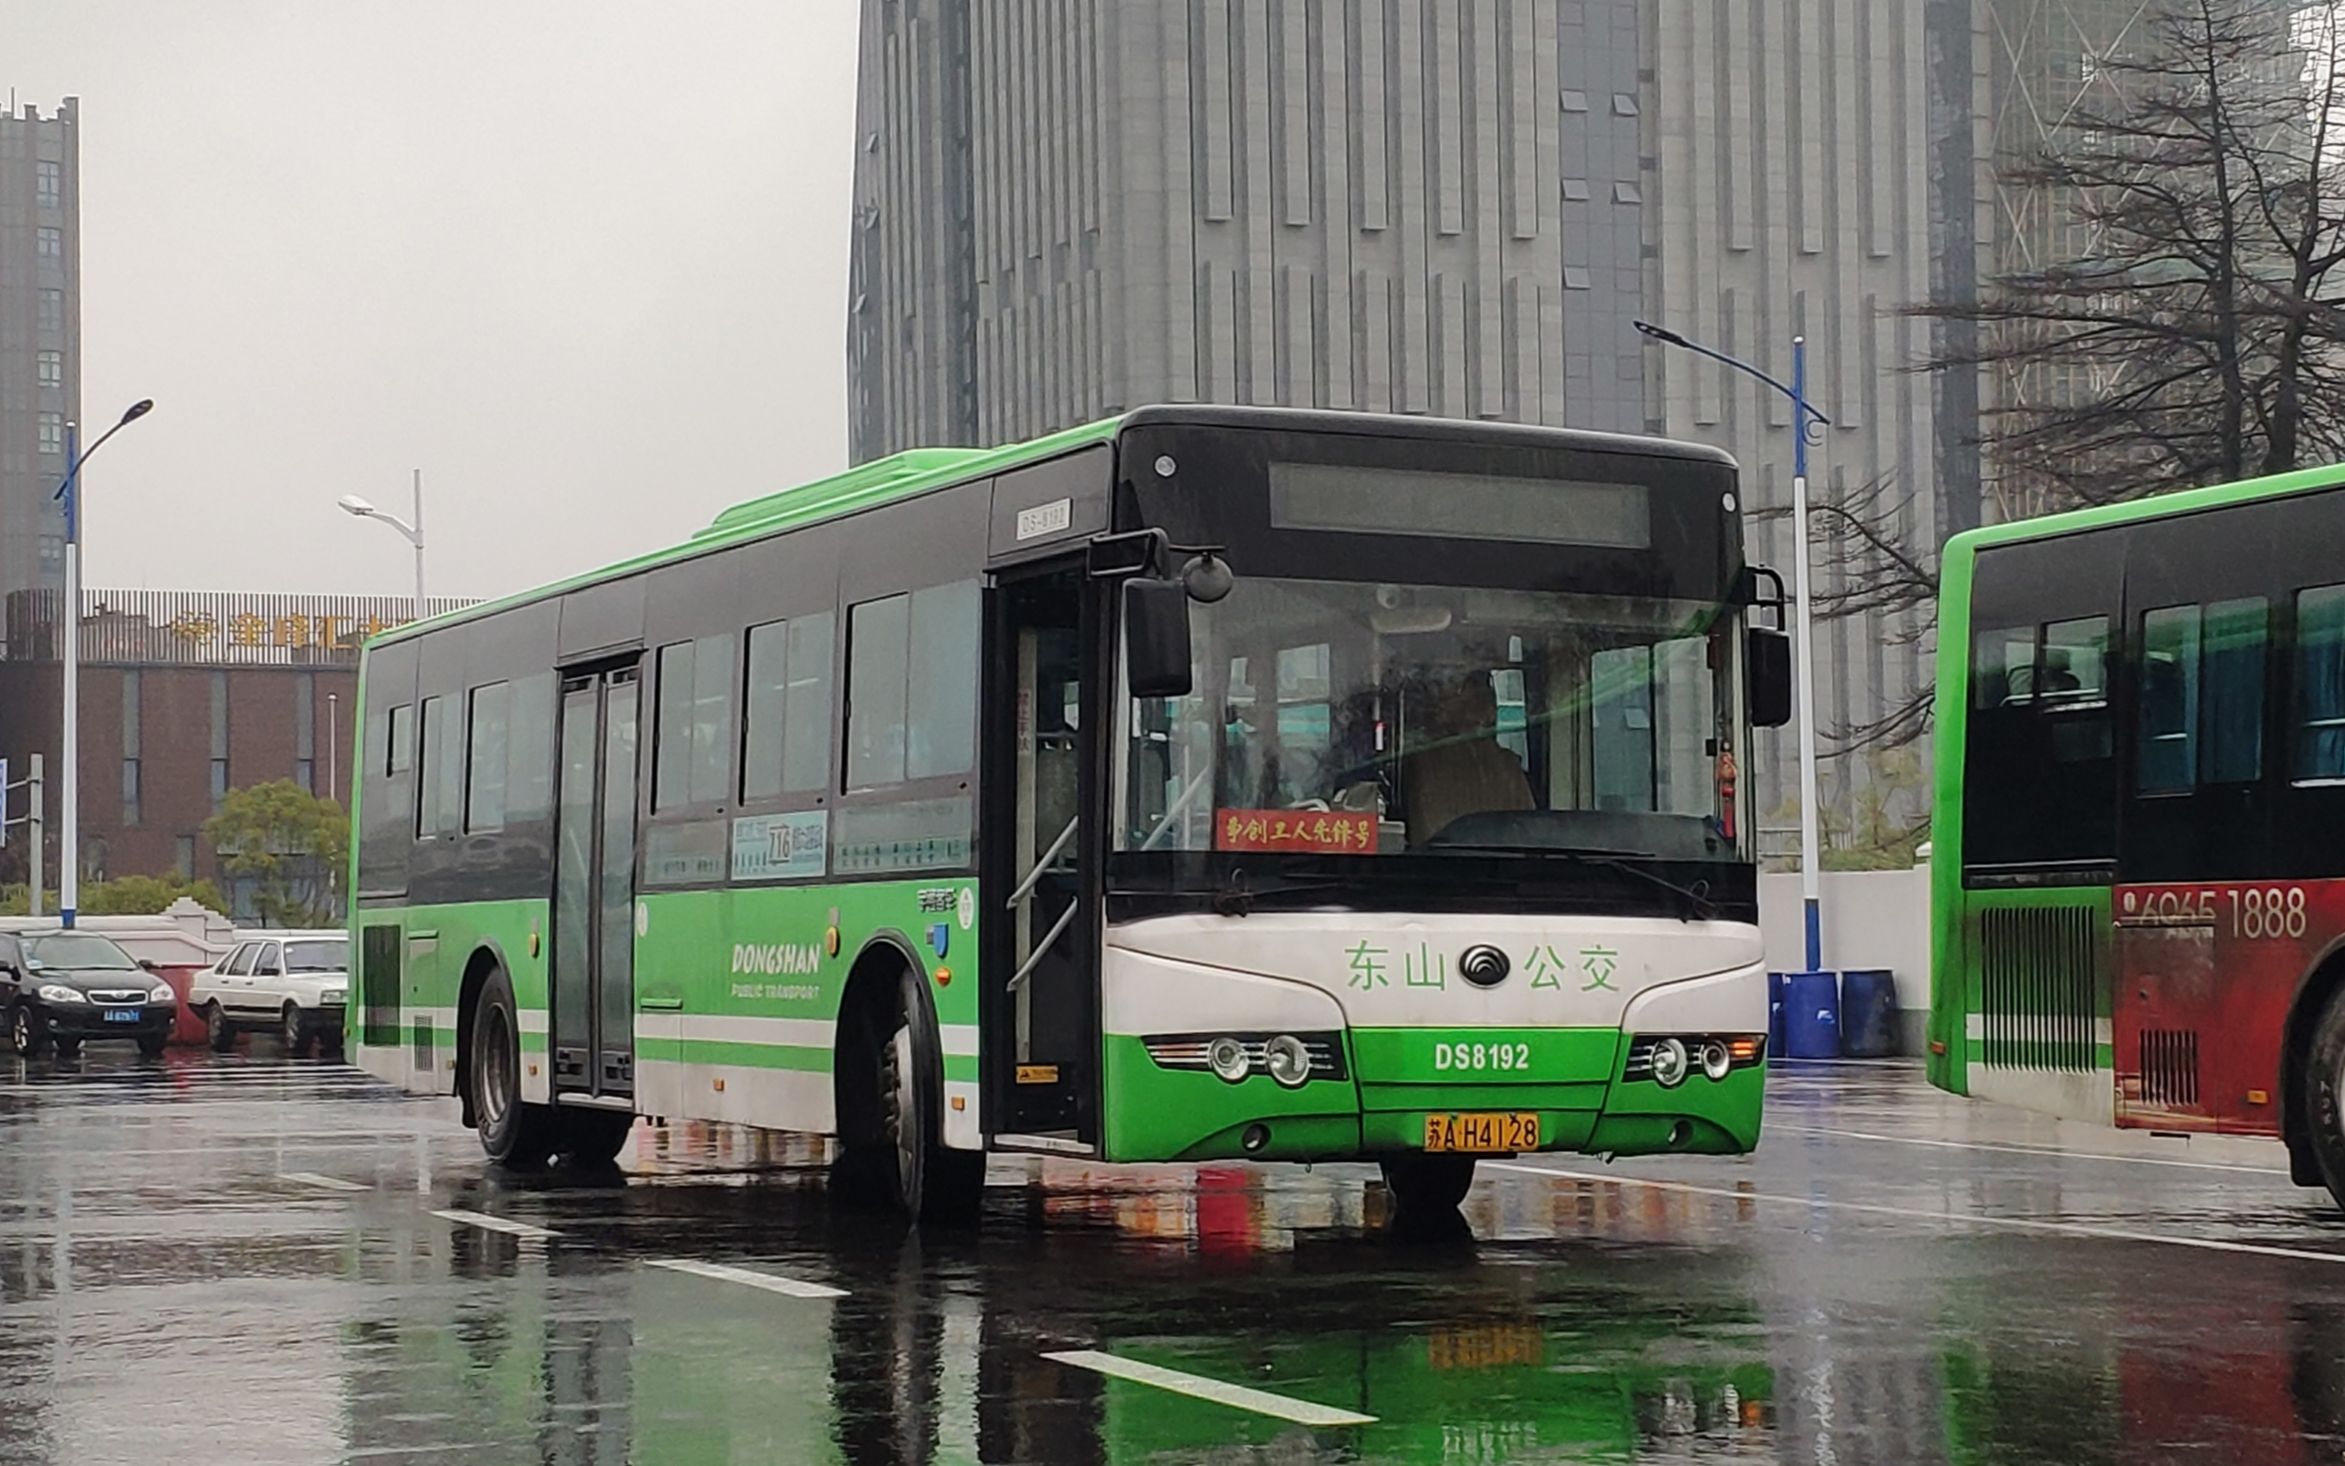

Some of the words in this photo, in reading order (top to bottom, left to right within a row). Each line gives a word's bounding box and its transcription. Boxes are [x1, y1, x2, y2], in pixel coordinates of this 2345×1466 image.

[769, 830, 790, 859] 716
[1226, 815, 1370, 849] 争创工人先锋号
[2227, 887, 2306, 938] 1888
[732, 943, 820, 974] DONGSHAN
[1344, 940, 1445, 991] 东山
[1524, 944, 1620, 992] 公交
[732, 984, 763, 998] PUBLIC
[765, 984, 820, 999] TRANSPORT
[1435, 1043, 1530, 1070] DS8192
